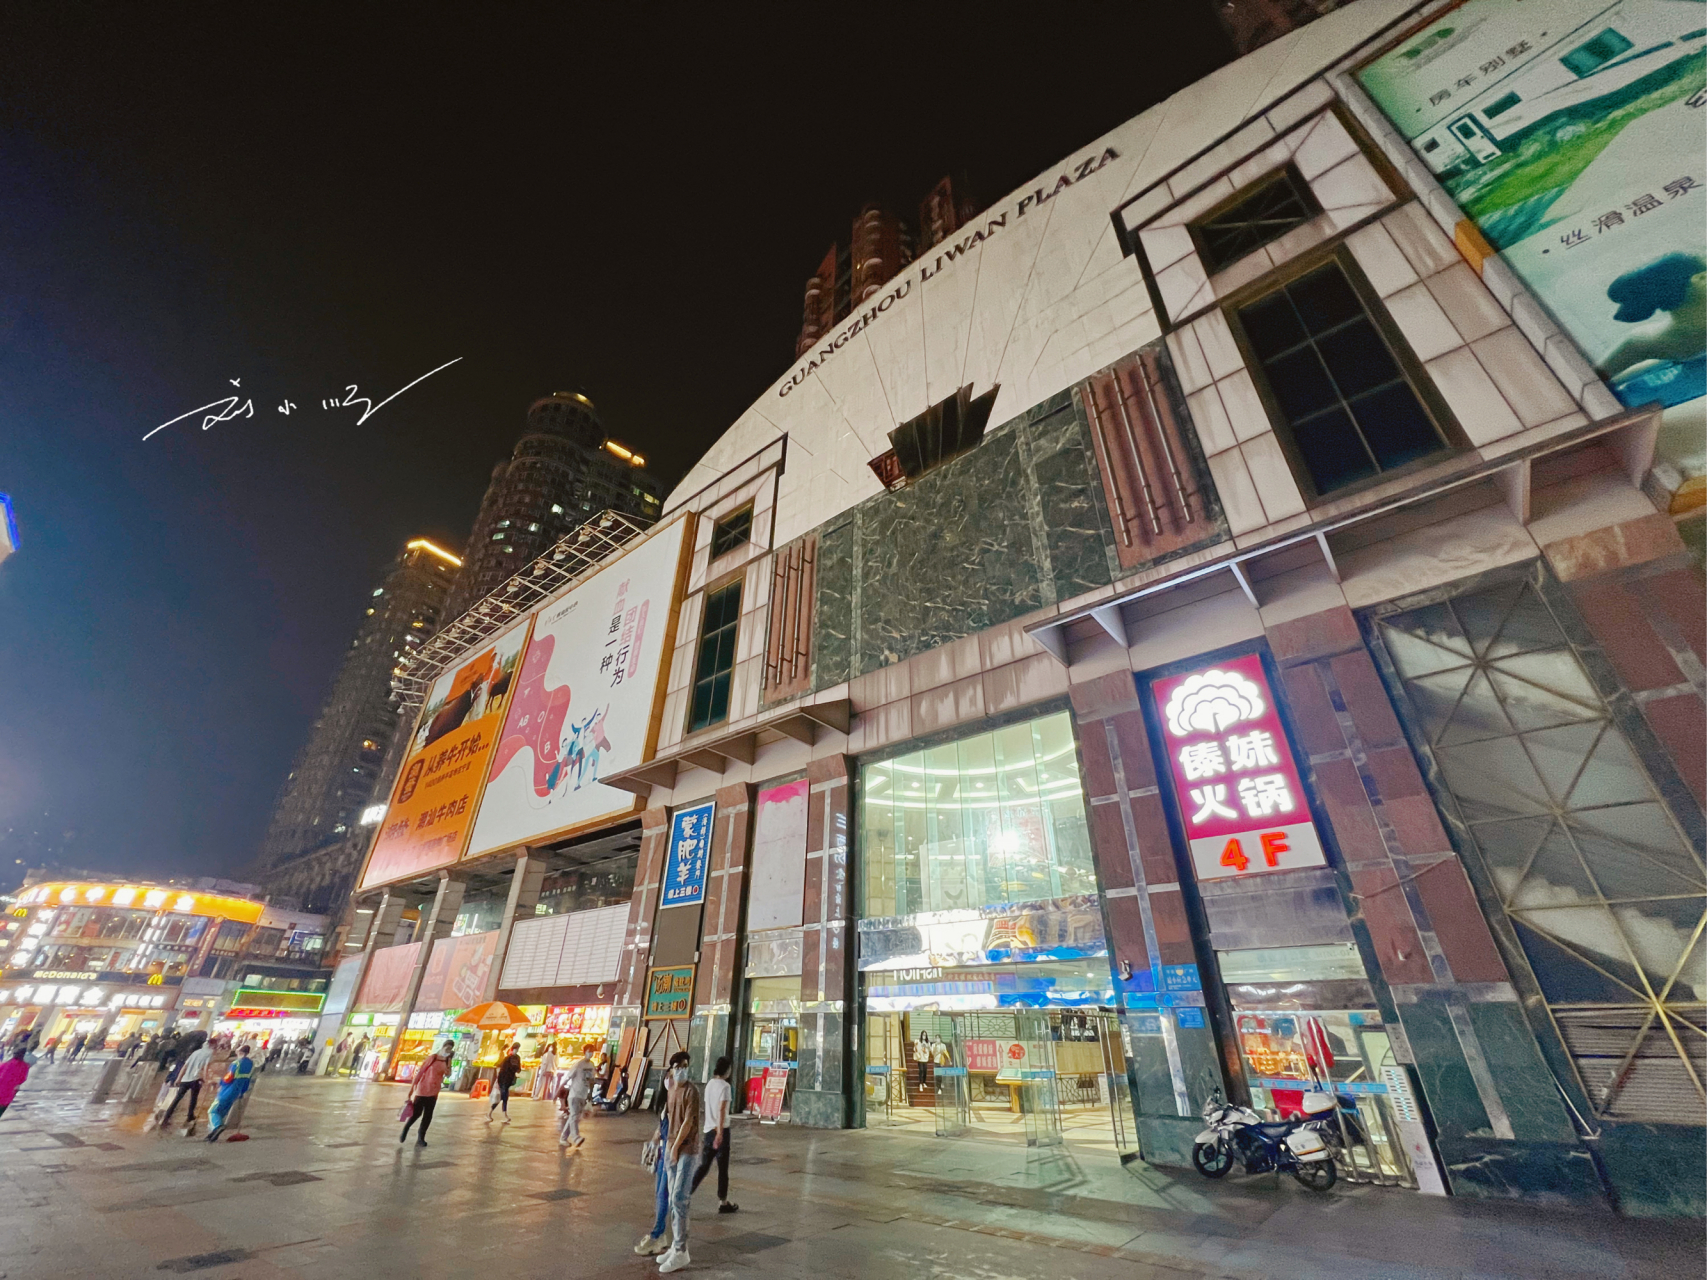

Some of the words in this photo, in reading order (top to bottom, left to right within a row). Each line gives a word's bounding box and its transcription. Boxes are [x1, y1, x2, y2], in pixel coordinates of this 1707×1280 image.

[1429, 39, 1533, 107] 房车别墅
[1561, 176, 1703, 250] 丝滑温泉
[779, 280, 912, 398] GUANGZHOU
[920, 211, 1008, 283] LIWAN
[1016, 147, 1121, 219] PLAZA
[517, 714, 530, 729] AB
[1179, 730, 1278, 780] 傣妹
[1190, 773, 1294, 824] 火锅
[677, 814, 699, 885] 蒙肥羊
[33, 970, 97, 980] McDonald's
